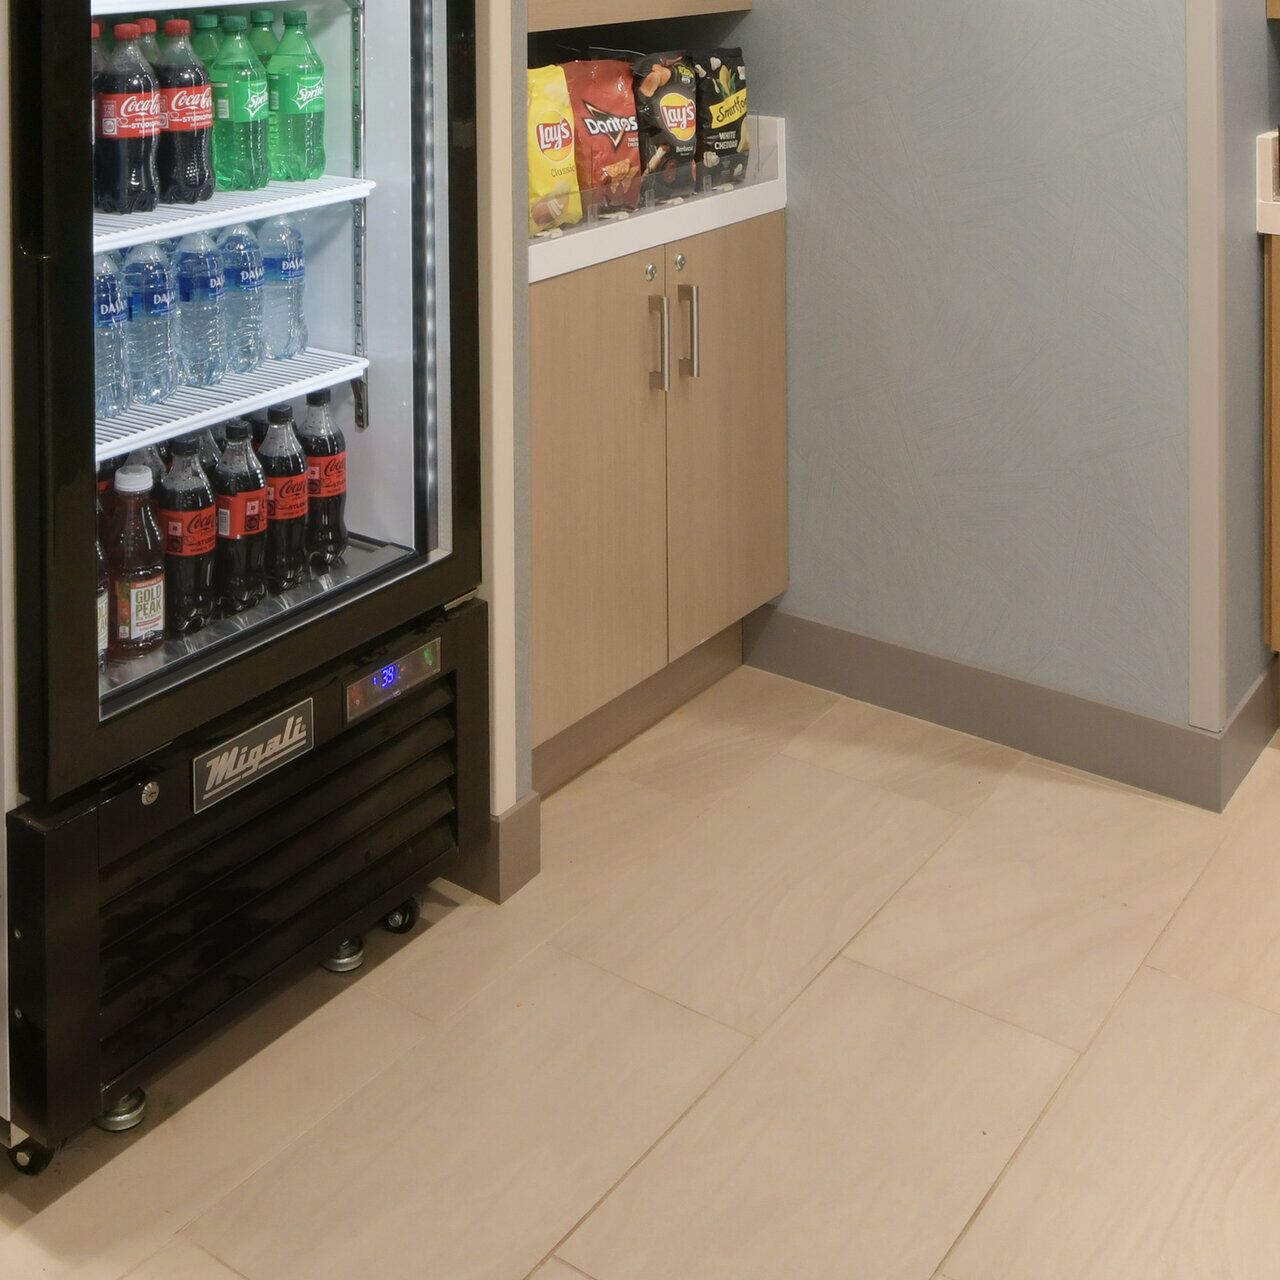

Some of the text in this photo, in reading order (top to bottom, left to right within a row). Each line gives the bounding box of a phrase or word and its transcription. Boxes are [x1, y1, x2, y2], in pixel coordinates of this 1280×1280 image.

[663, 104, 695, 127] Lay's
[585, 117, 638, 135] Doritos
[539, 121, 572, 149] Lay's
[719, 131, 736, 140] WHITE
[715, 140, 737, 149] CHEDDAR
[551, 165, 576, 177] Classic
[136, 588, 161, 603] GOLD
[136, 599, 161, 616] PEAK
[205, 716, 306, 790] Migali
